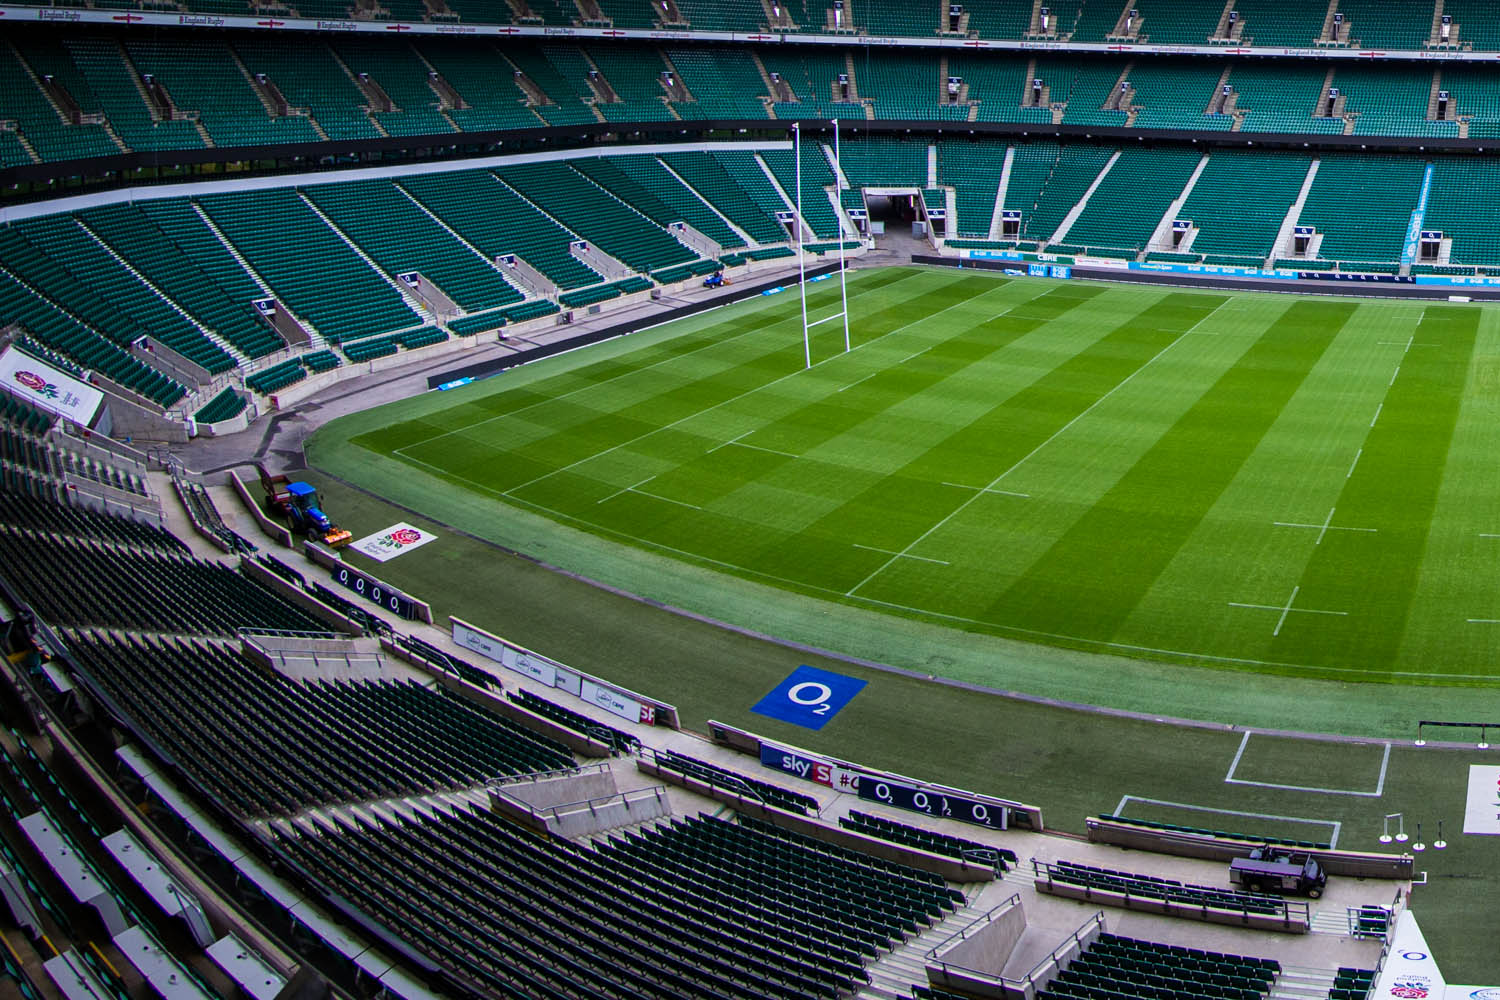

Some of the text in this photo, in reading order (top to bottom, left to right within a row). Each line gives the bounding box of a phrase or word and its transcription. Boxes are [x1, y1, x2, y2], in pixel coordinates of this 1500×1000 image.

[44, 11, 64, 20] England
[184, 16, 224, 26] England Rugby
[321, 21, 357, 30] England Rugby
[788, 682, 832, 715] O2
[782, 755, 810, 777] sky
[875, 783, 932, 813] O2 O2
[972, 804, 991, 824] O2
